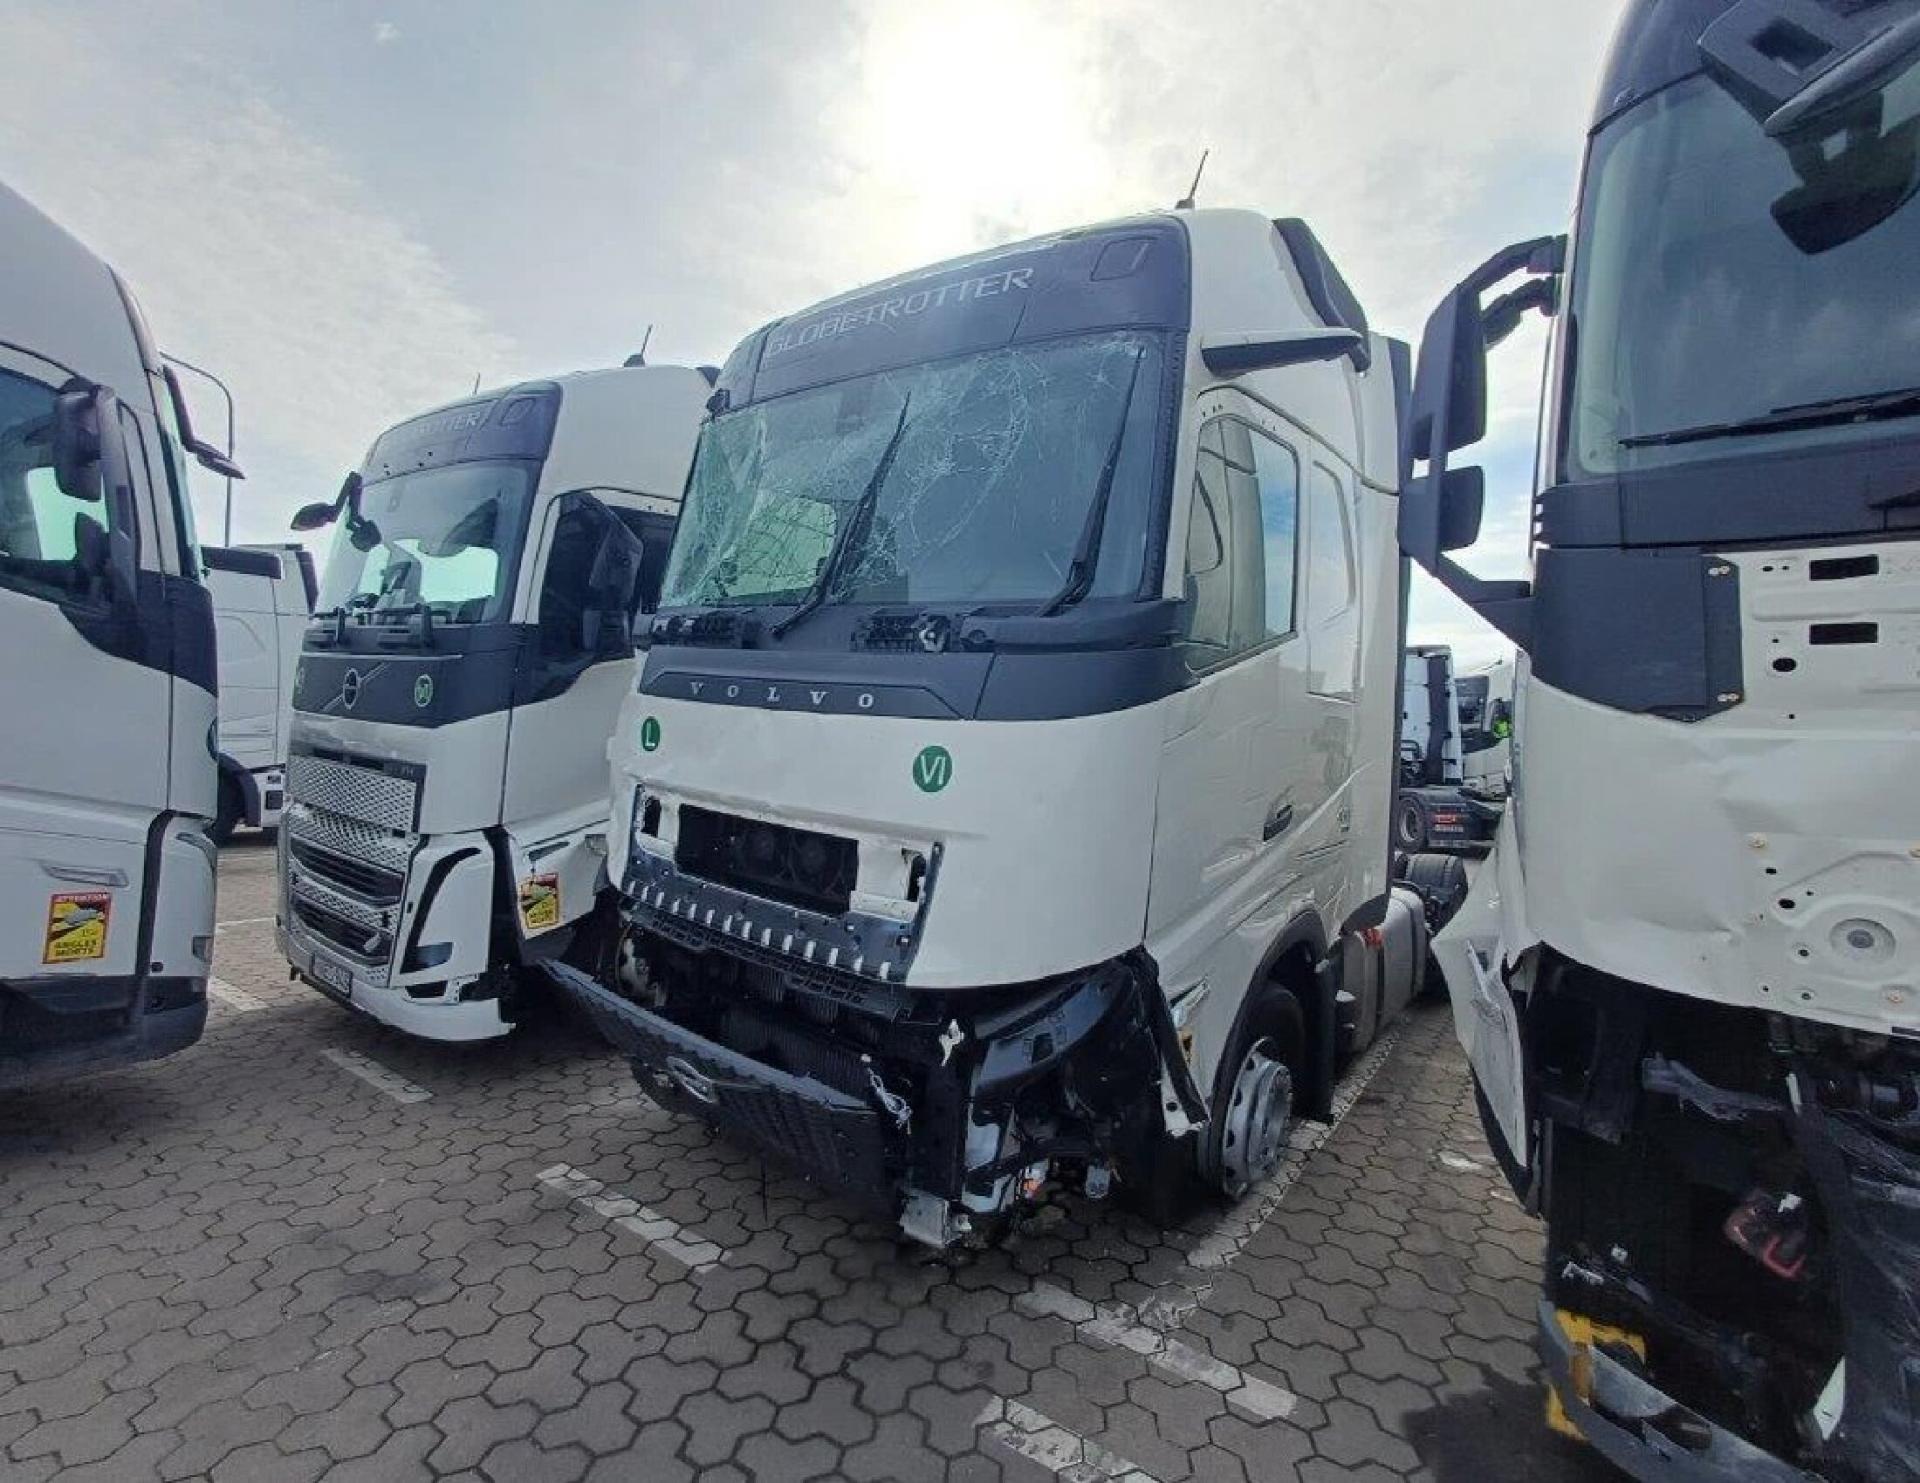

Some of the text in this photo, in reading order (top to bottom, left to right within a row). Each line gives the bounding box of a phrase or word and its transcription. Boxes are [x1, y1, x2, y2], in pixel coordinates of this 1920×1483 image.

[766, 266, 1034, 355] GLOBETROTTER
[690, 681, 875, 708] VOLVO
[645, 722, 656, 748] L
[919, 754, 947, 786] VI
